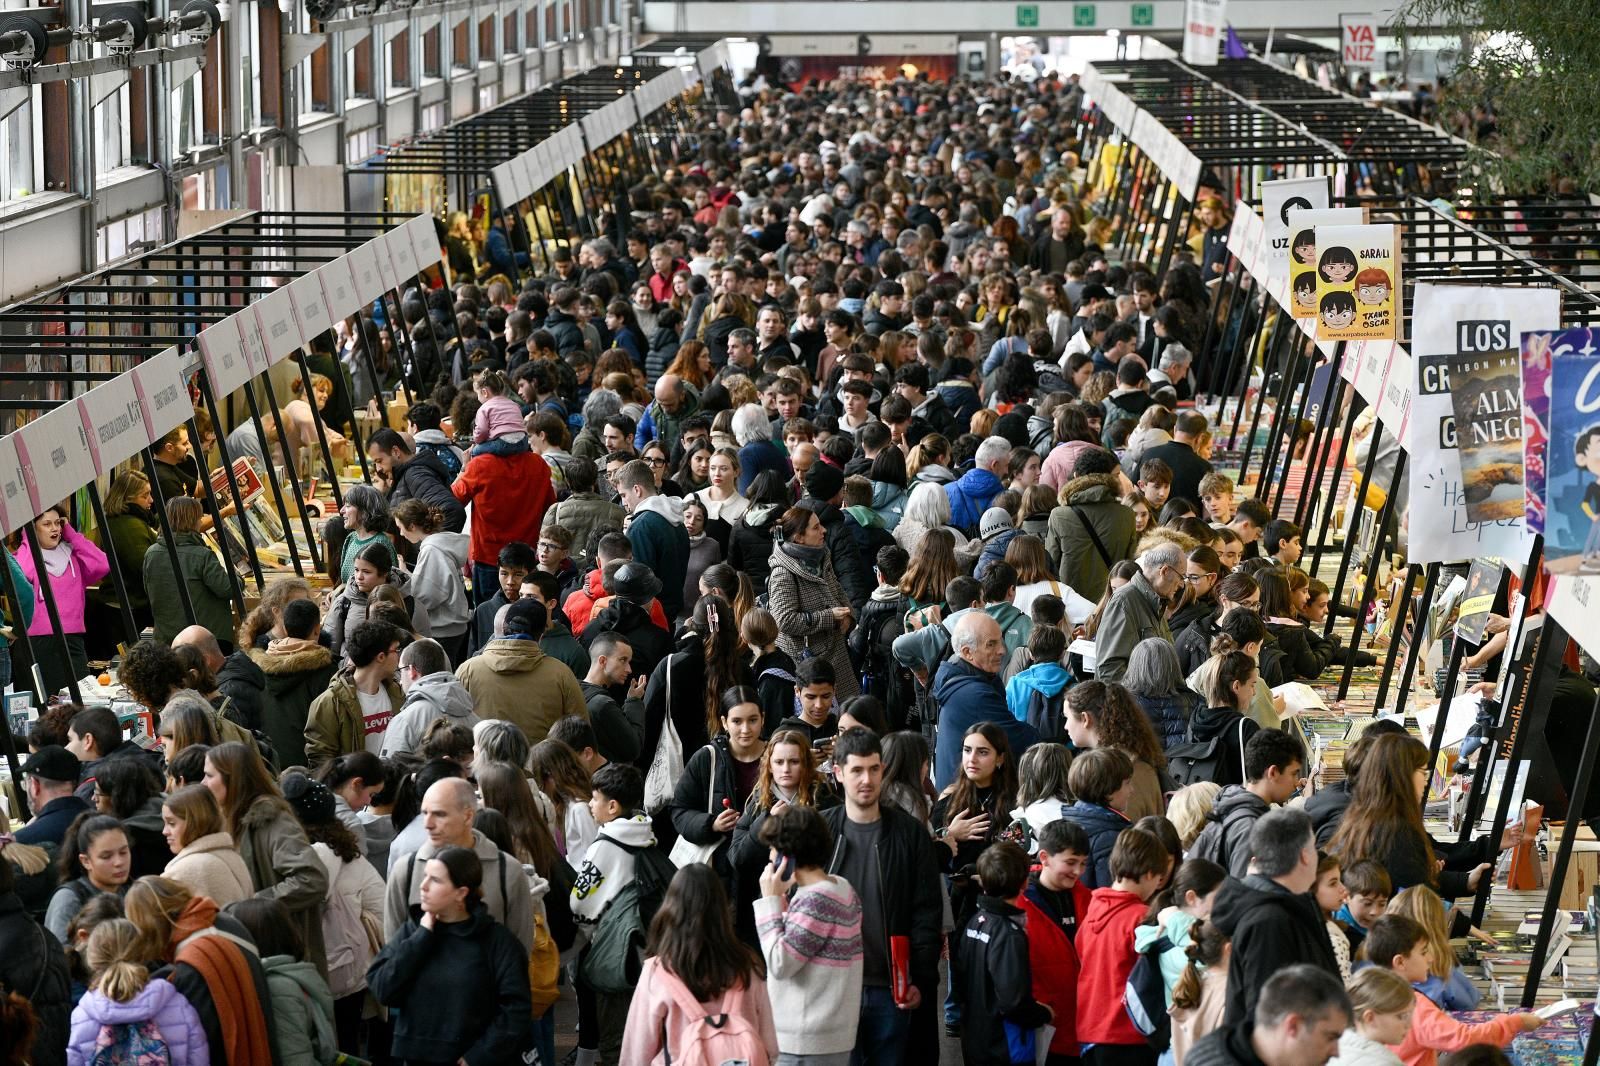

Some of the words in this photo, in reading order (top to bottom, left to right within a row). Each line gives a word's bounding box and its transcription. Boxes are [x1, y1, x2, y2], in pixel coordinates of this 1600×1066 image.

[1362, 310, 1390, 320] TXANO
[1362, 318, 1390, 329] OSCAR
[1461, 323, 1507, 352] LOS
[1457, 361, 1489, 374] IBON
